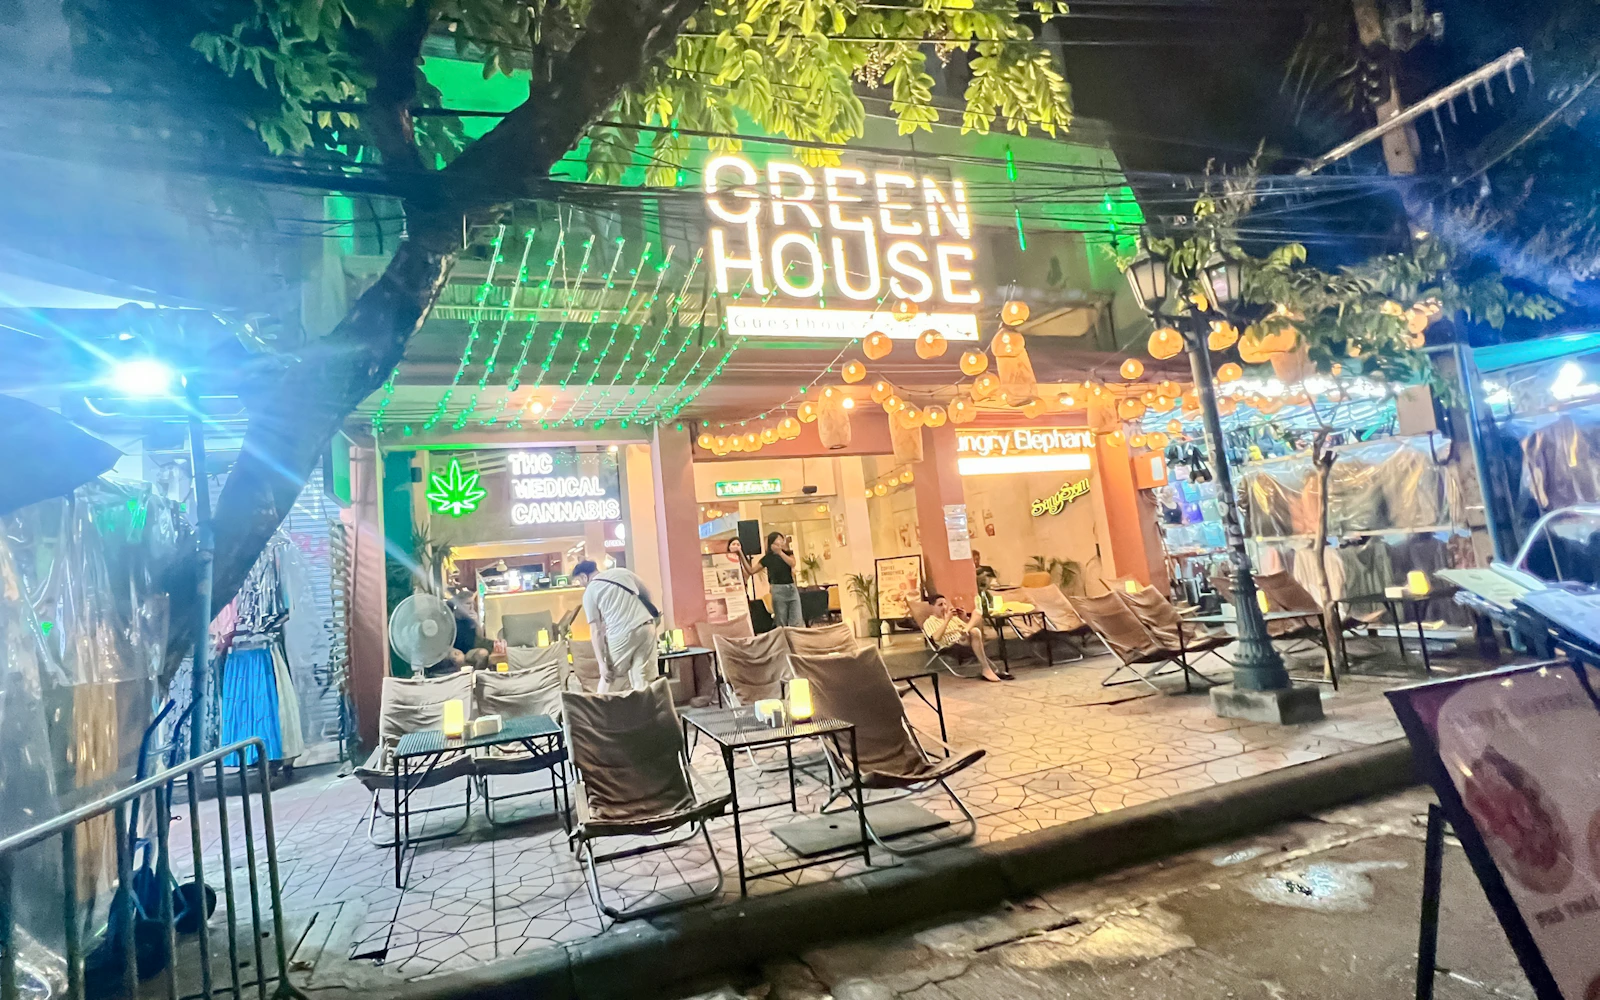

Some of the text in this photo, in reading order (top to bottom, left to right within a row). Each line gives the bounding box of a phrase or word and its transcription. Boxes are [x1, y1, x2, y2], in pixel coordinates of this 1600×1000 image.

[705, 155, 971, 239] GREEN
[710, 229, 980, 304] HOUSE
[1014, 429, 1095, 453] Elephant
[508, 452, 553, 475] THC
[511, 476, 605, 499] MEDICAL
[511, 498, 620, 524] CANNABIS
